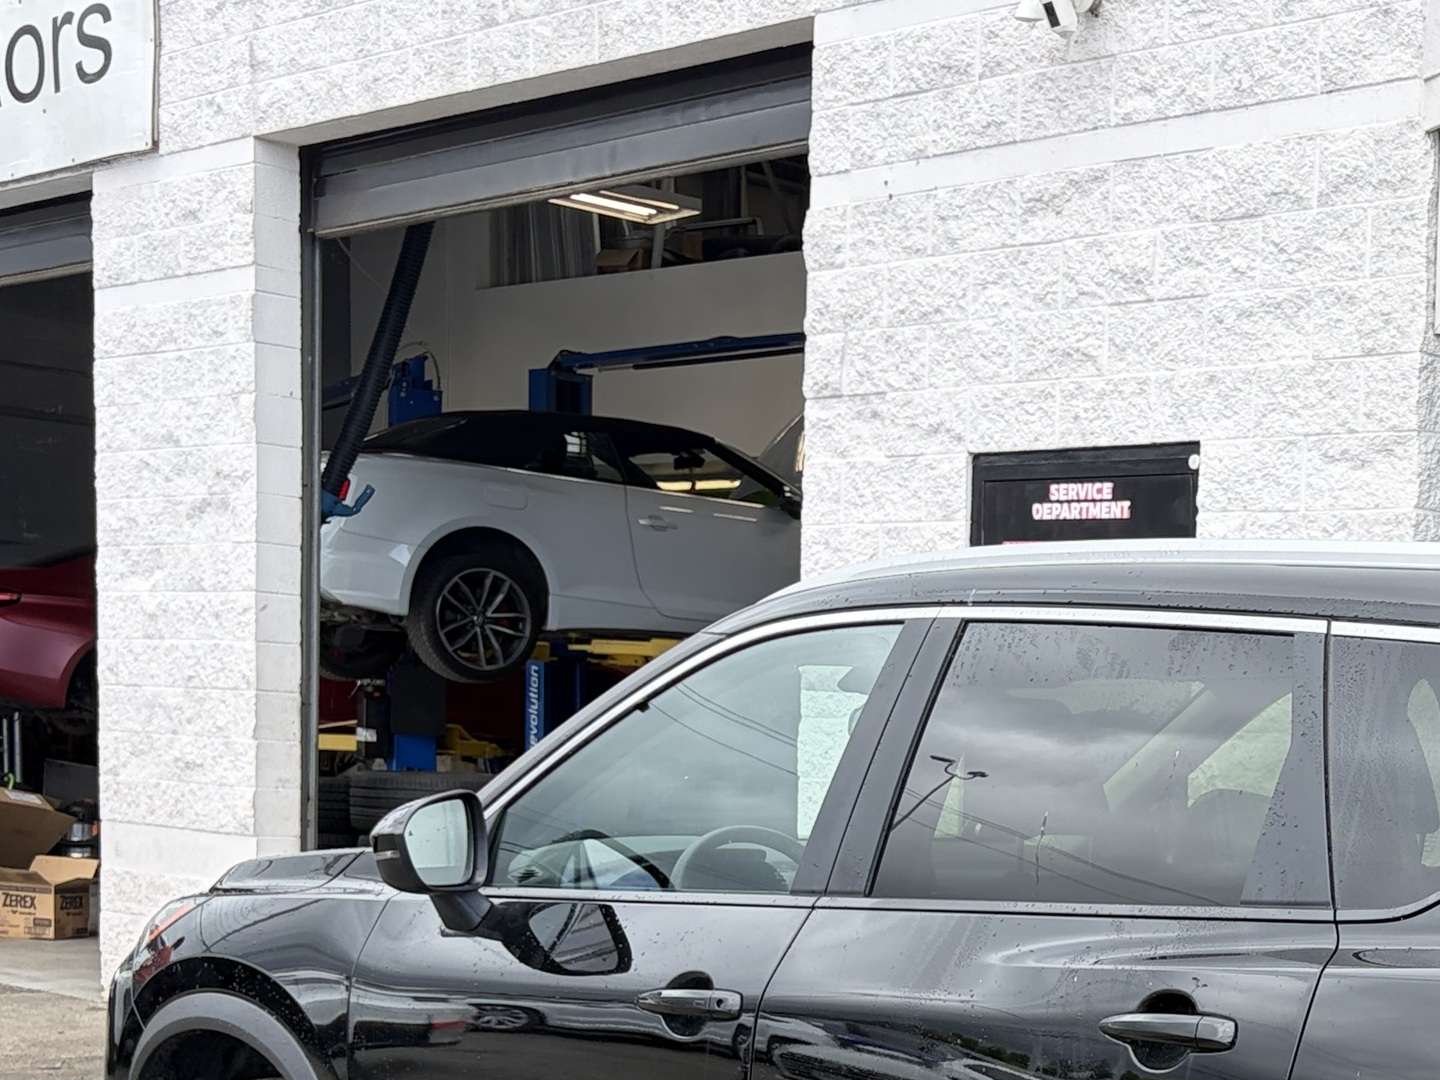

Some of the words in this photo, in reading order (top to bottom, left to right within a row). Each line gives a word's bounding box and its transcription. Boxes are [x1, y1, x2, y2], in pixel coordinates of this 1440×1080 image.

[0, 3, 112, 104] ors
[1049, 482, 1114, 501] SERVICE
[1031, 500, 1131, 521] DEPARTMENT
[528, 664, 540, 750] evolution
[1, 892, 37, 911] ZEREX
